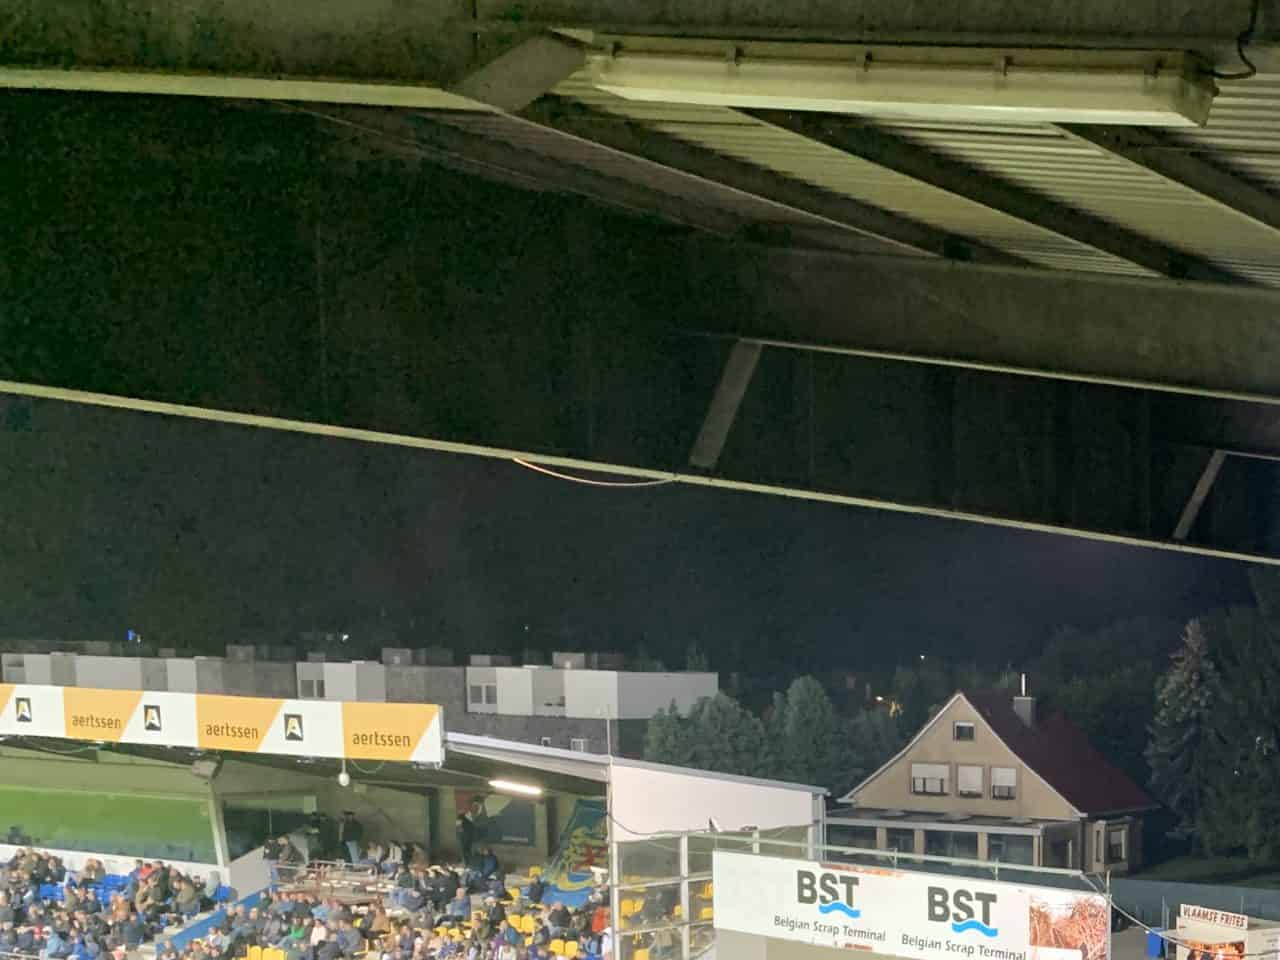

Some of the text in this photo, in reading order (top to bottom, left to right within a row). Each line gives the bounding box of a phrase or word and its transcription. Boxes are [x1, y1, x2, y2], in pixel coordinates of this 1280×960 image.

[71, 713, 121, 729] aertssen
[206, 721, 259, 740] aertssen
[352, 730, 411, 747] aertssen
[797, 869, 860, 908] BST
[927, 886, 998, 925] BST
[1183, 906, 1246, 927] VLAAMSE FRITES
[774, 915, 886, 942] Belgian Scrap Terminal
[901, 934, 942, 951] Belgian
[945, 940, 975, 957] Scrap
